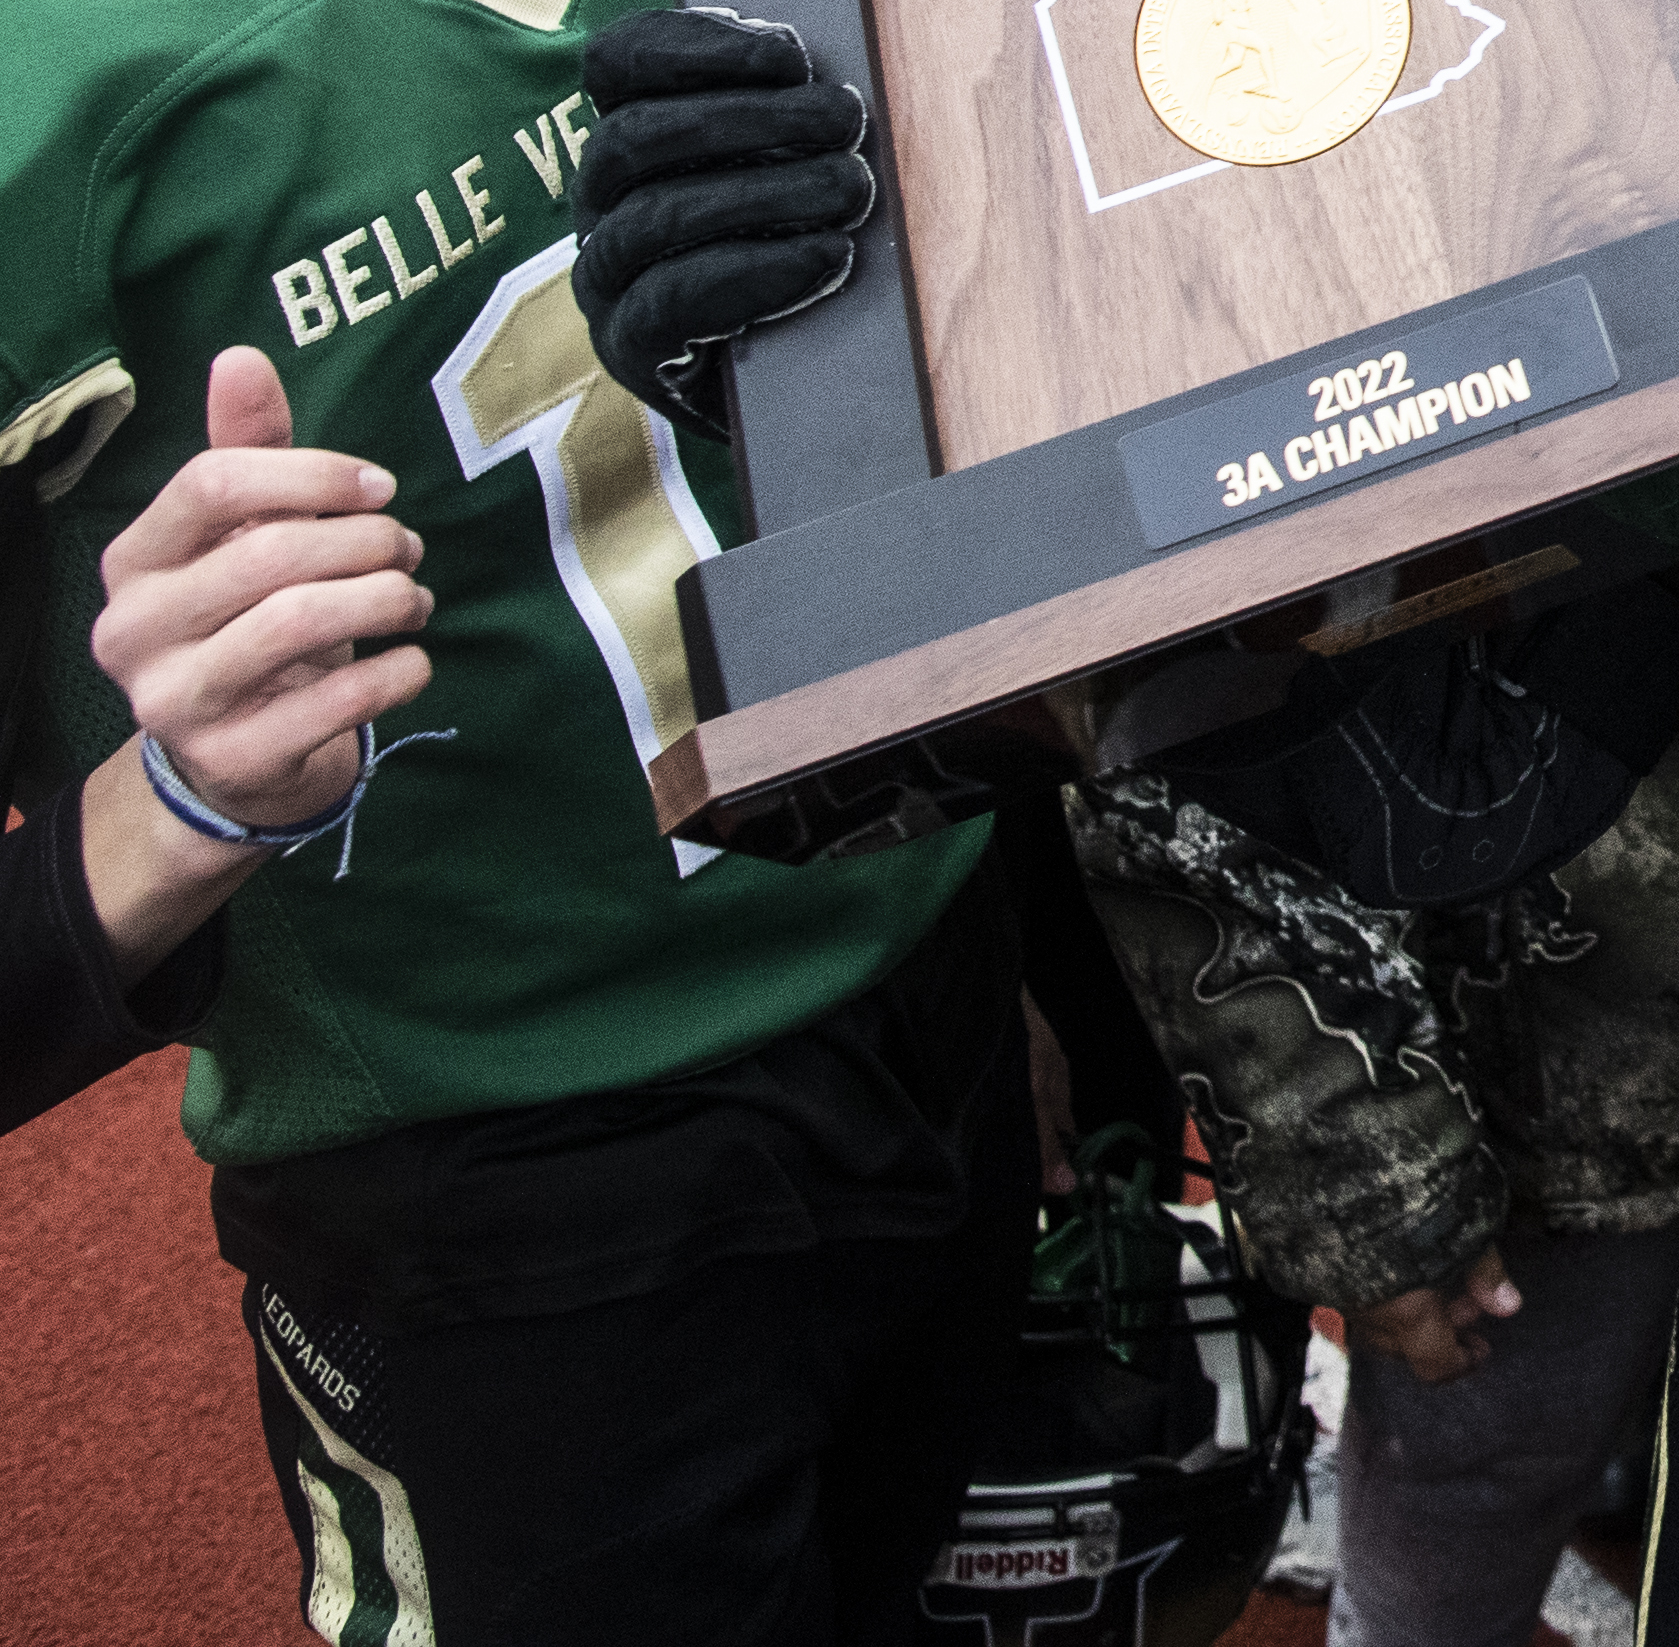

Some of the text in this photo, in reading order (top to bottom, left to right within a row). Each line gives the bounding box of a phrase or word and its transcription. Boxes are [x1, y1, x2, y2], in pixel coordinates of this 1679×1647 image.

[271, 154, 508, 348] BELLE
[1216, 358, 1532, 509] 3A CHAMPION
[1308, 350, 1415, 422] 2022
[956, 1548, 1069, 1581] Riddell
